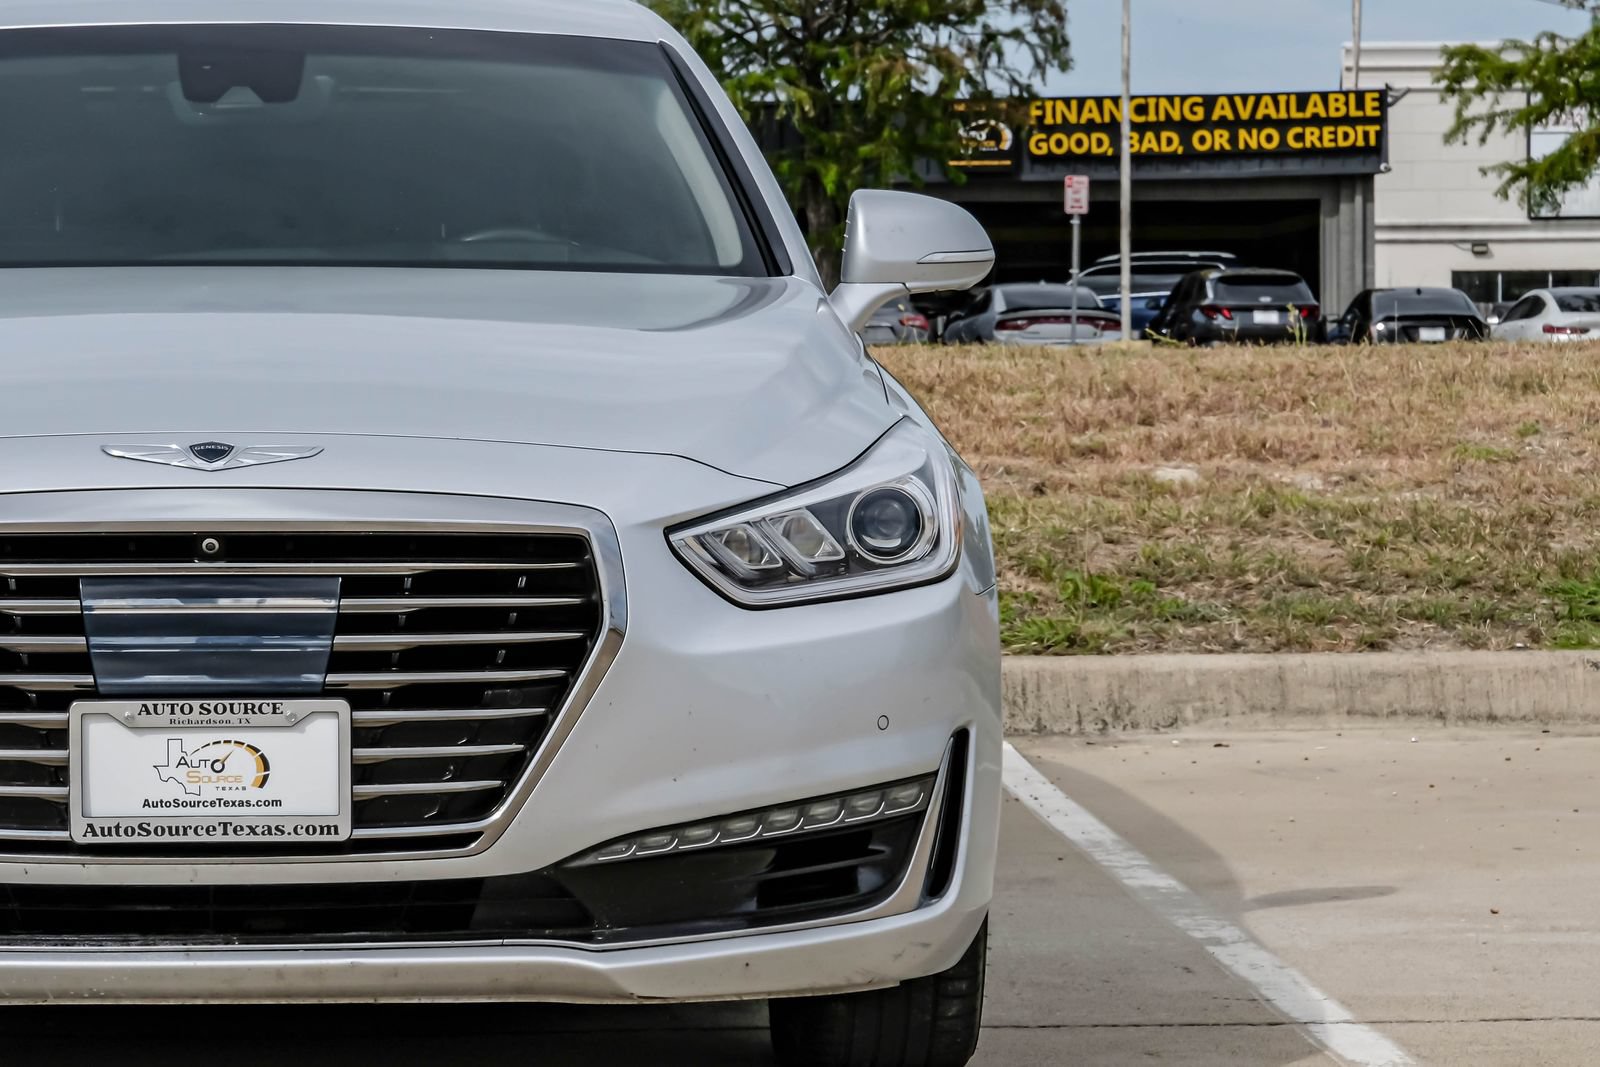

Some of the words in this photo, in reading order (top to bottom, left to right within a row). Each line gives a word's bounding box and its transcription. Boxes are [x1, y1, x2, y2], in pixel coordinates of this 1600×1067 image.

[1029, 96, 1205, 125] FINANCING
[1211, 92, 1381, 121] AVAILABLE
[1029, 132, 1114, 156] GOOD,
[1122, 131, 1184, 155] BAD,
[1191, 129, 1232, 151] OR
[1238, 127, 1280, 149] NO
[1286, 125, 1381, 148] CREDIT
[137, 703, 194, 716] AUTO
[198, 702, 284, 715] SOURCE
[237, 717, 252, 725] TX
[142, 798, 282, 809] AutoSourceTexas.com
[82, 821, 340, 838] AutoSourceTexas.com
